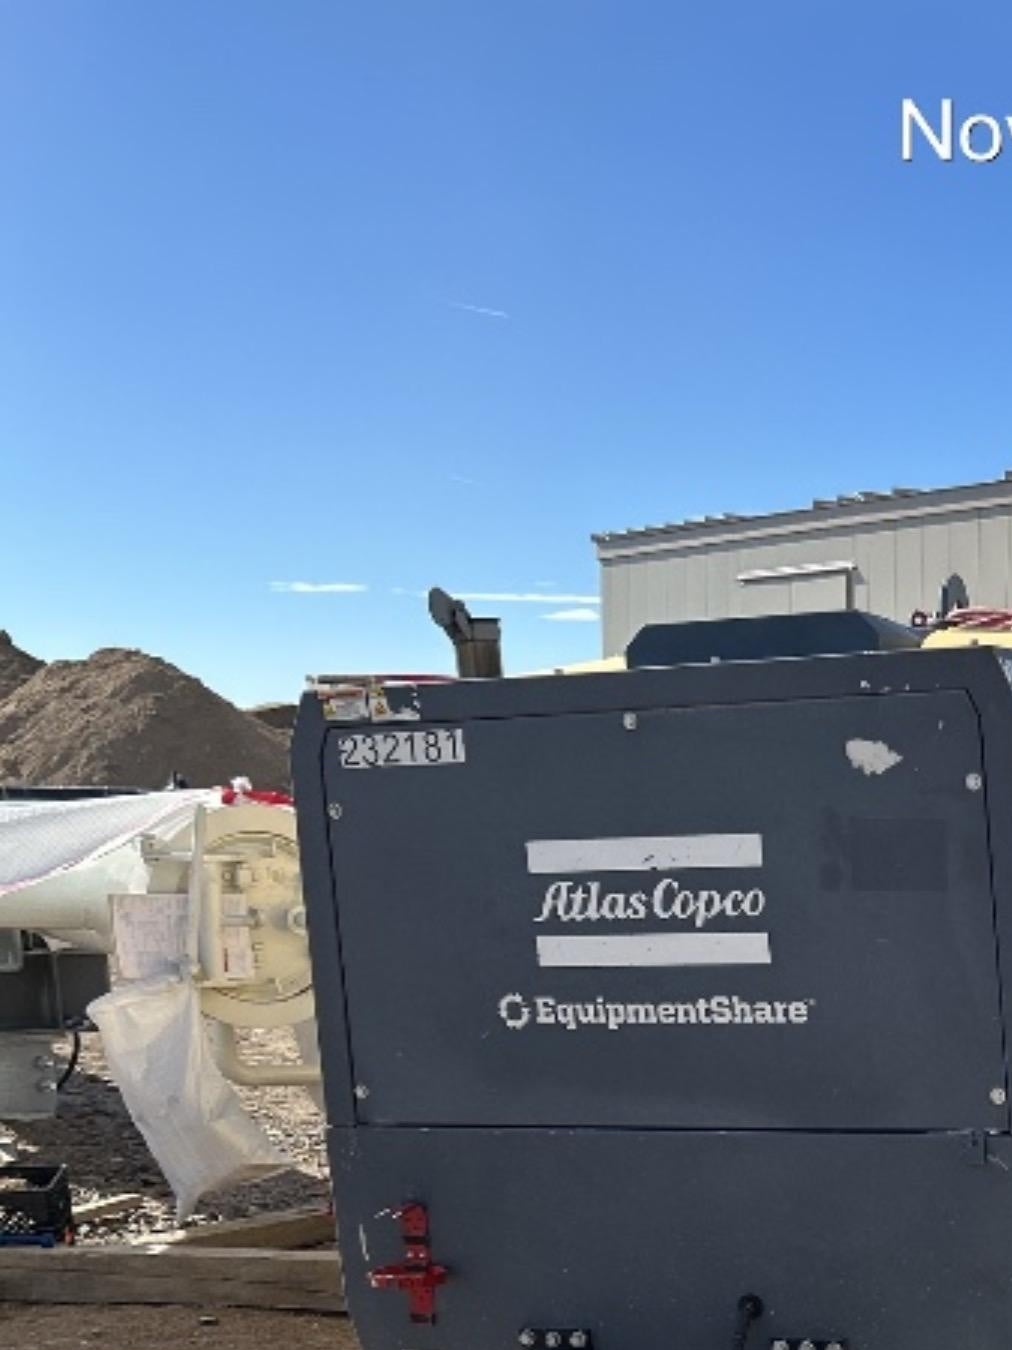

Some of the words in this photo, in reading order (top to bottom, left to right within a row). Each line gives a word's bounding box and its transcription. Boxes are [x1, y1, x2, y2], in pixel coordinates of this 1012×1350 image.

[338, 730, 459, 768] 232181
[533, 881, 649, 922] Atlas
[652, 877, 767, 929] Copco
[534, 995, 810, 1031] EquipmentShare
